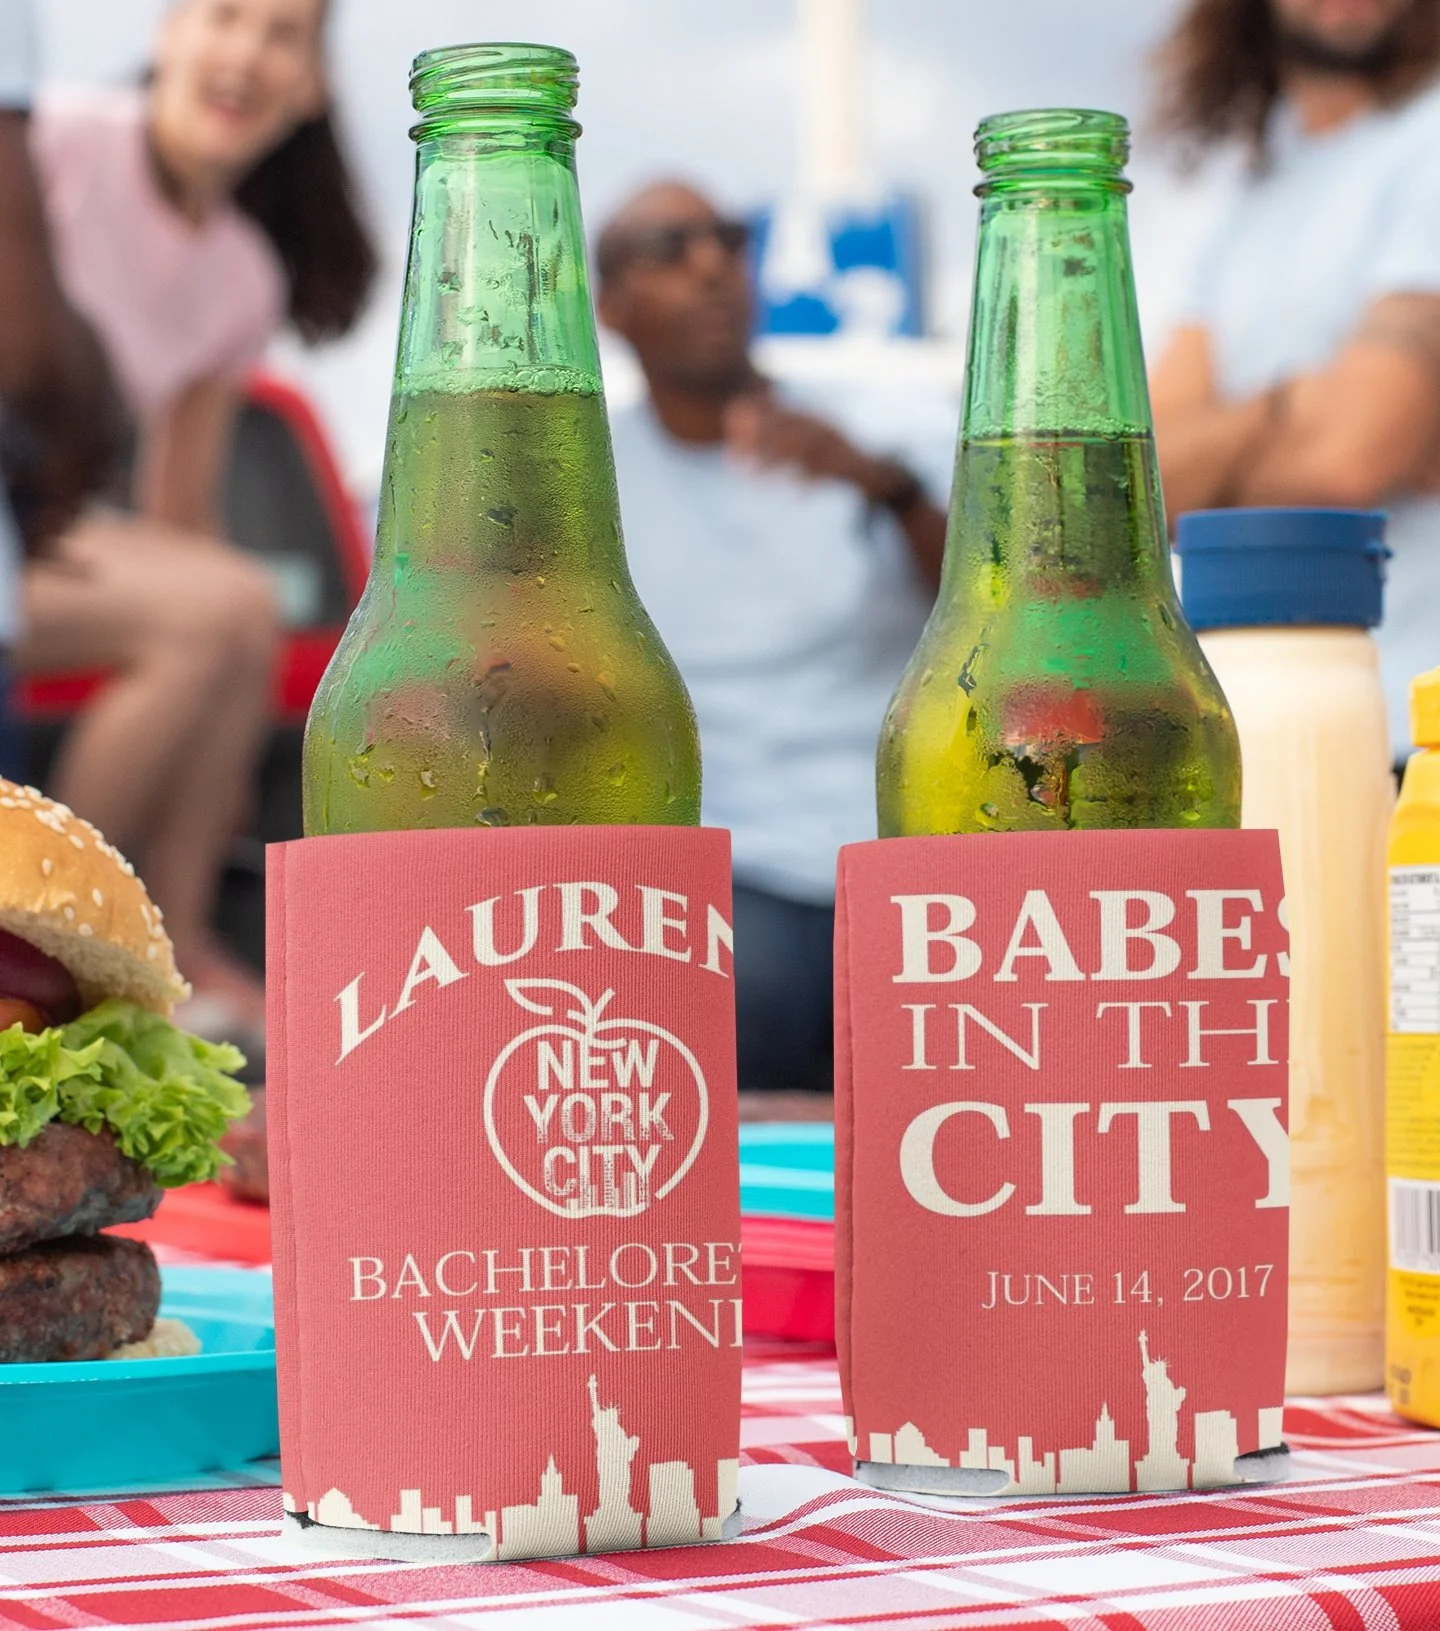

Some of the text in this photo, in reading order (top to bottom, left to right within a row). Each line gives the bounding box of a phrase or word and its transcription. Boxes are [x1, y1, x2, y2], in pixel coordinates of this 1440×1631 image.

[890, 889, 1290, 984] BABE
[537, 1039, 660, 1090] NEW
[901, 999, 1290, 1071] IN TH
[523, 1092, 674, 1143] YORK
[543, 1144, 662, 1208] CITY
[348, 1242, 742, 1302] BACHELORE
[978, 1264, 1274, 1309] JUNE 14, 2017
